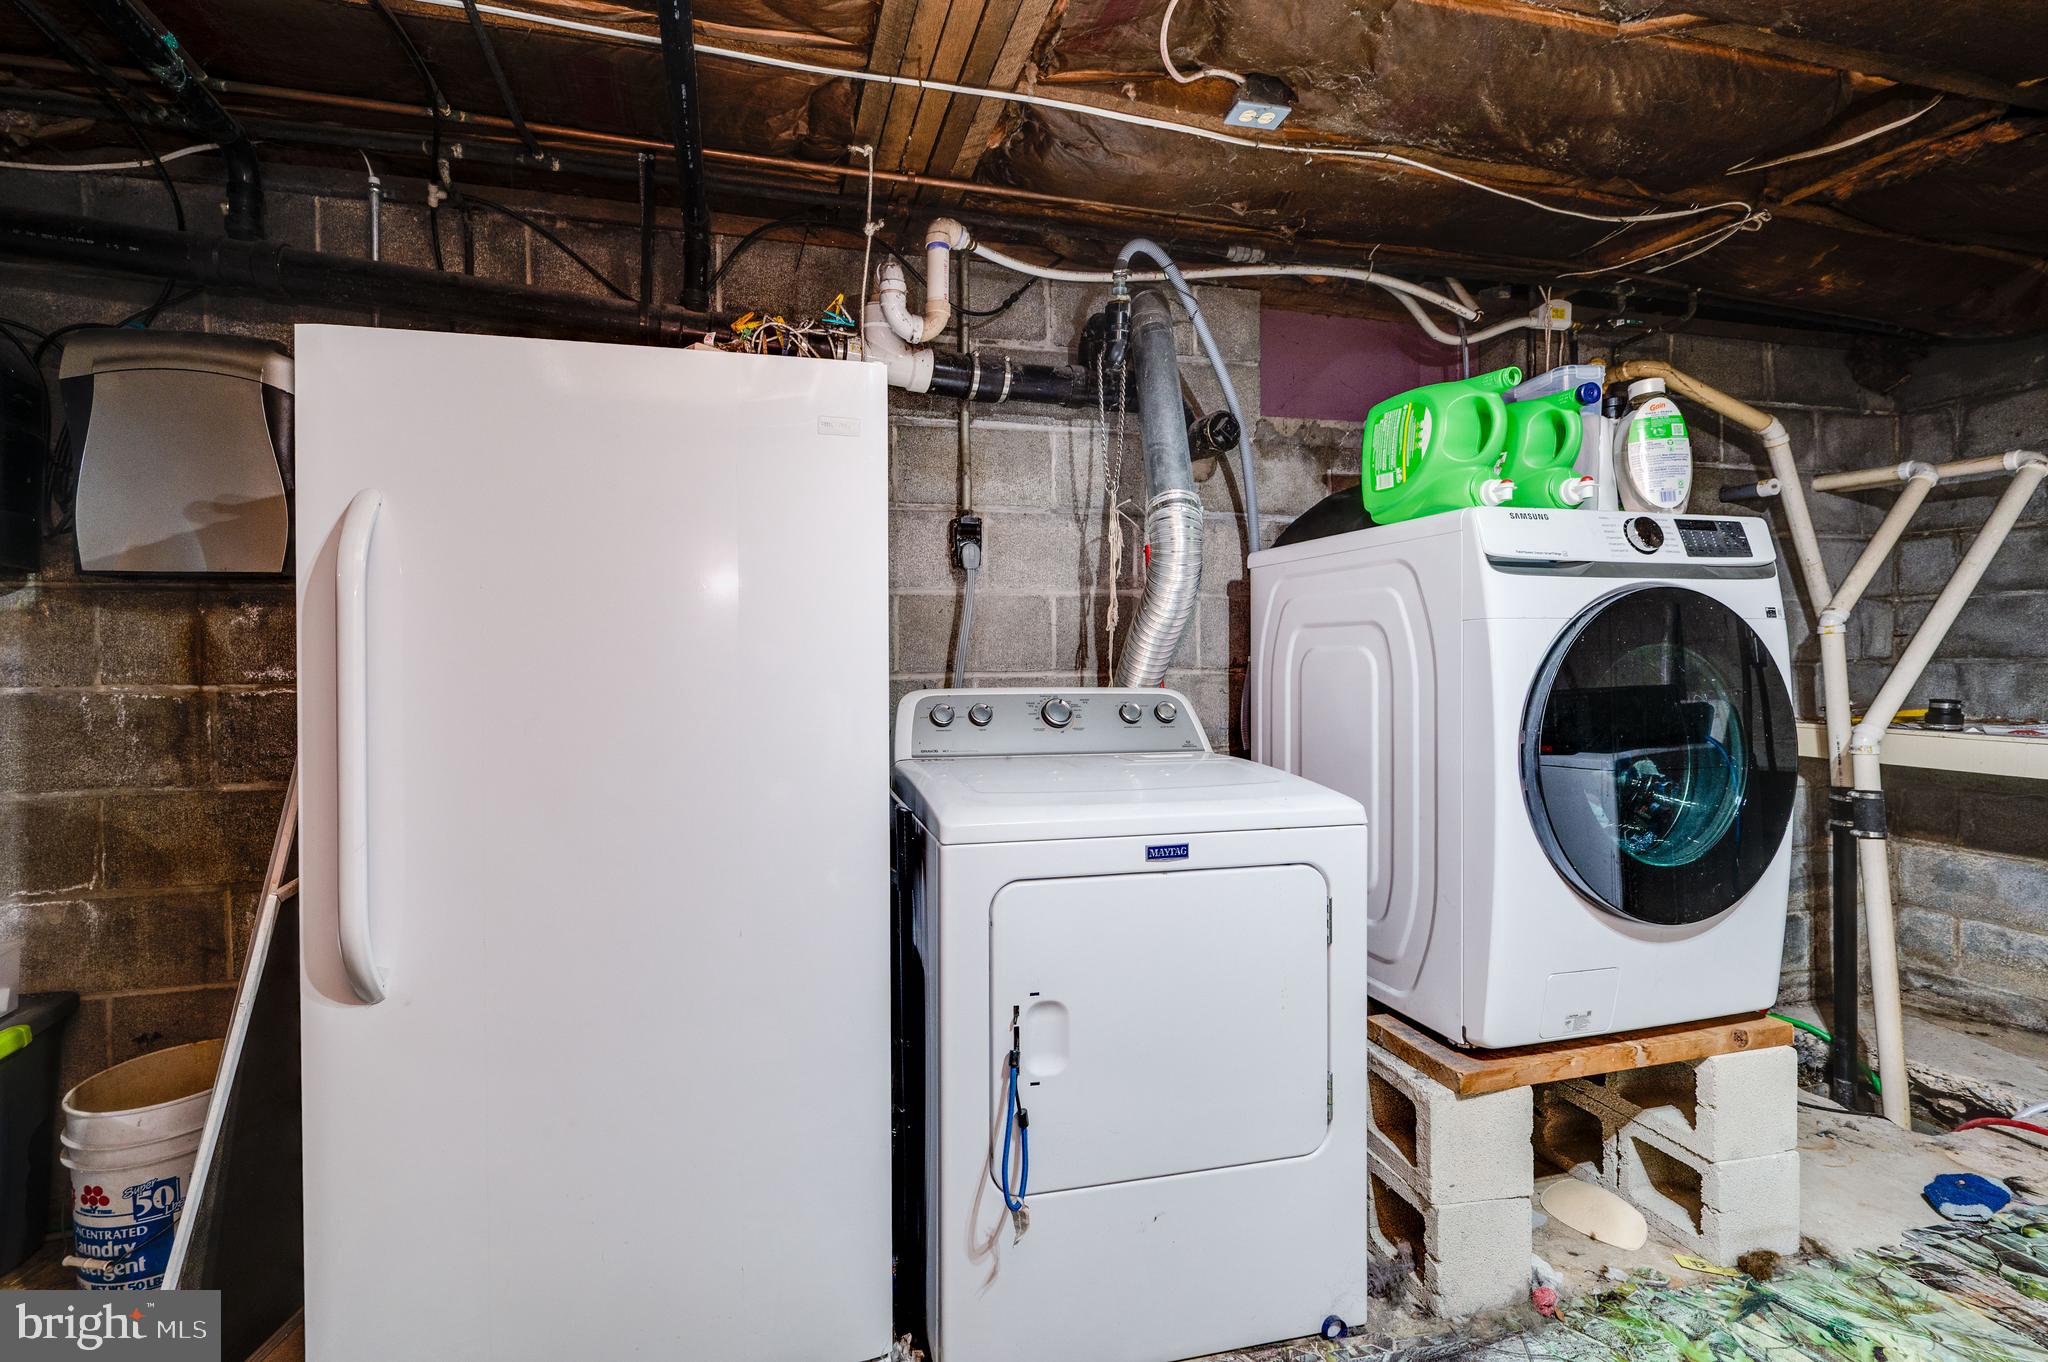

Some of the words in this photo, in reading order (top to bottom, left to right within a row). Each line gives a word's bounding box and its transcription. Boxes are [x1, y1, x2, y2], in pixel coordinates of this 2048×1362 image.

[1649, 402, 1667, 412] Gain
[1509, 512, 1550, 520] SAMSUNG
[1148, 846, 1187, 858] MAYTAG
[122, 1177, 159, 1200] Super
[136, 1185, 175, 1217] 50
